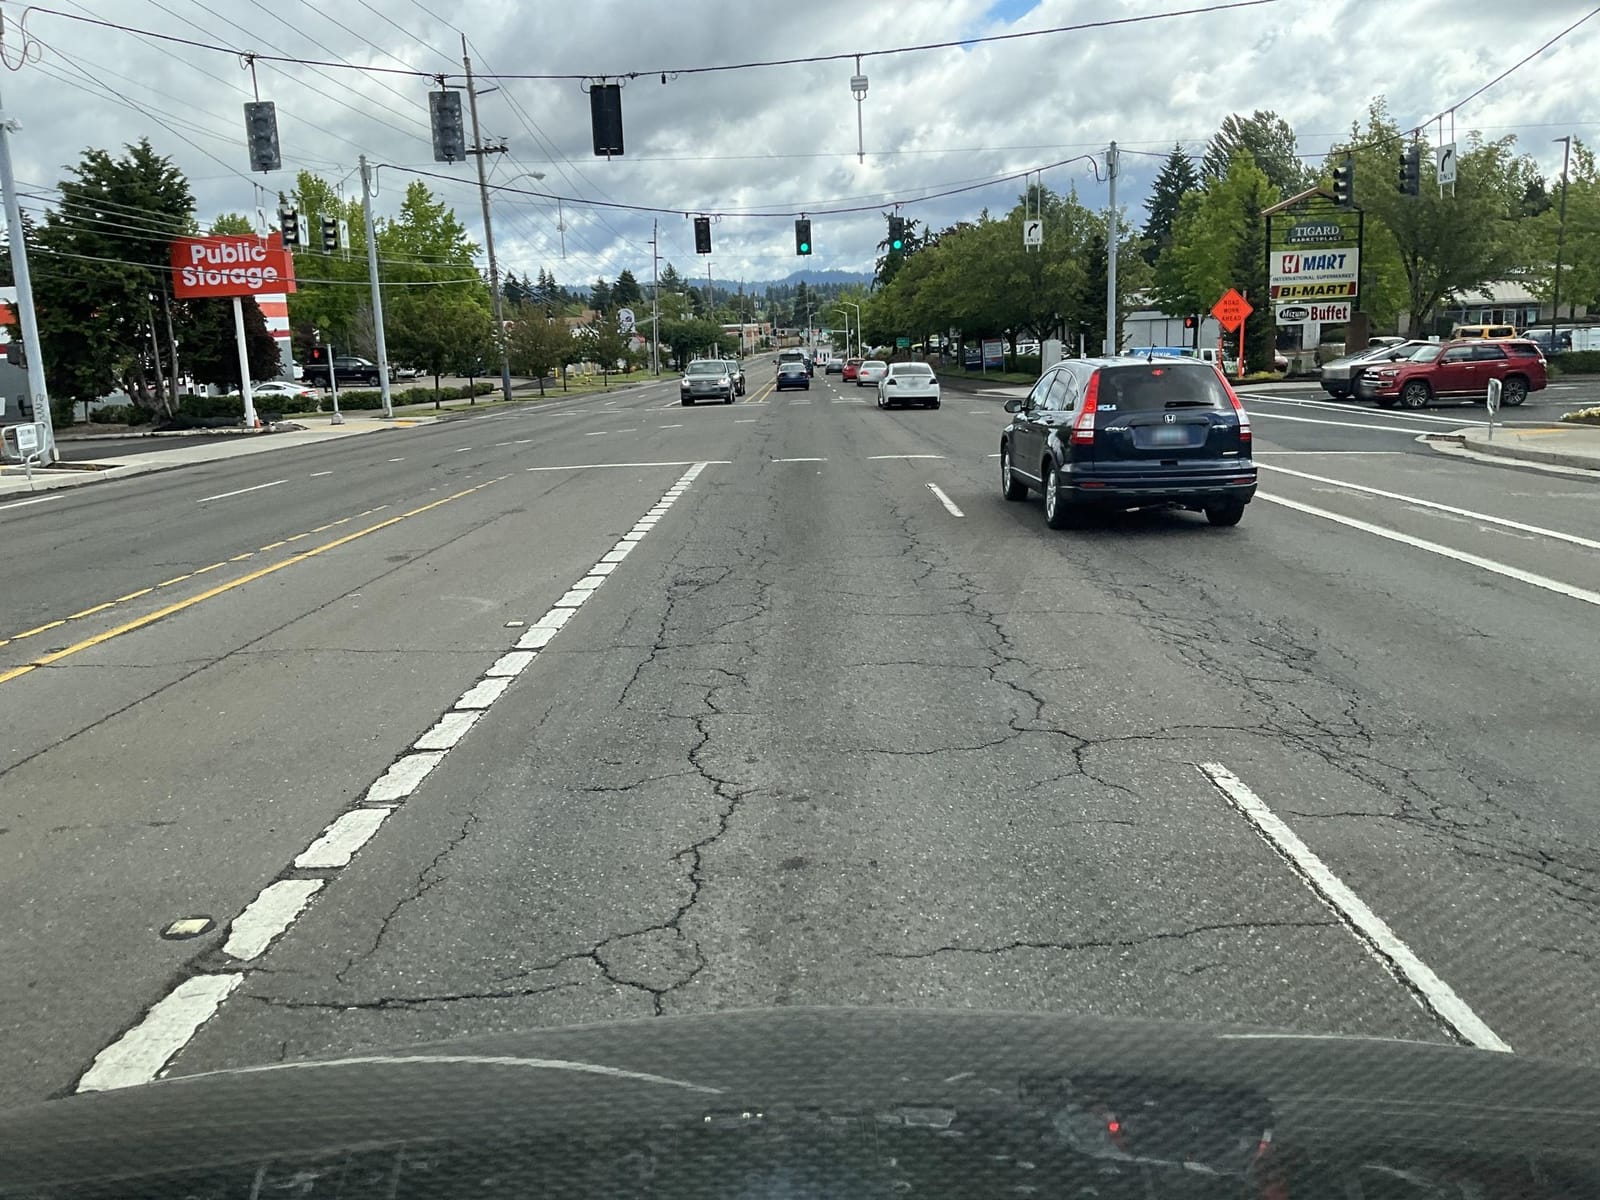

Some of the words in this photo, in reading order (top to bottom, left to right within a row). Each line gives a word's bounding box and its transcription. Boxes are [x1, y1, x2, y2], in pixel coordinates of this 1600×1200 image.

[1295, 226, 1339, 236] TIGARD
[190, 242, 267, 265] Public
[1303, 254, 1346, 270] MART
[182, 266, 278, 289] Storage
[1281, 284, 1347, 296] BI-MART
[1311, 305, 1348, 321] Buffet
